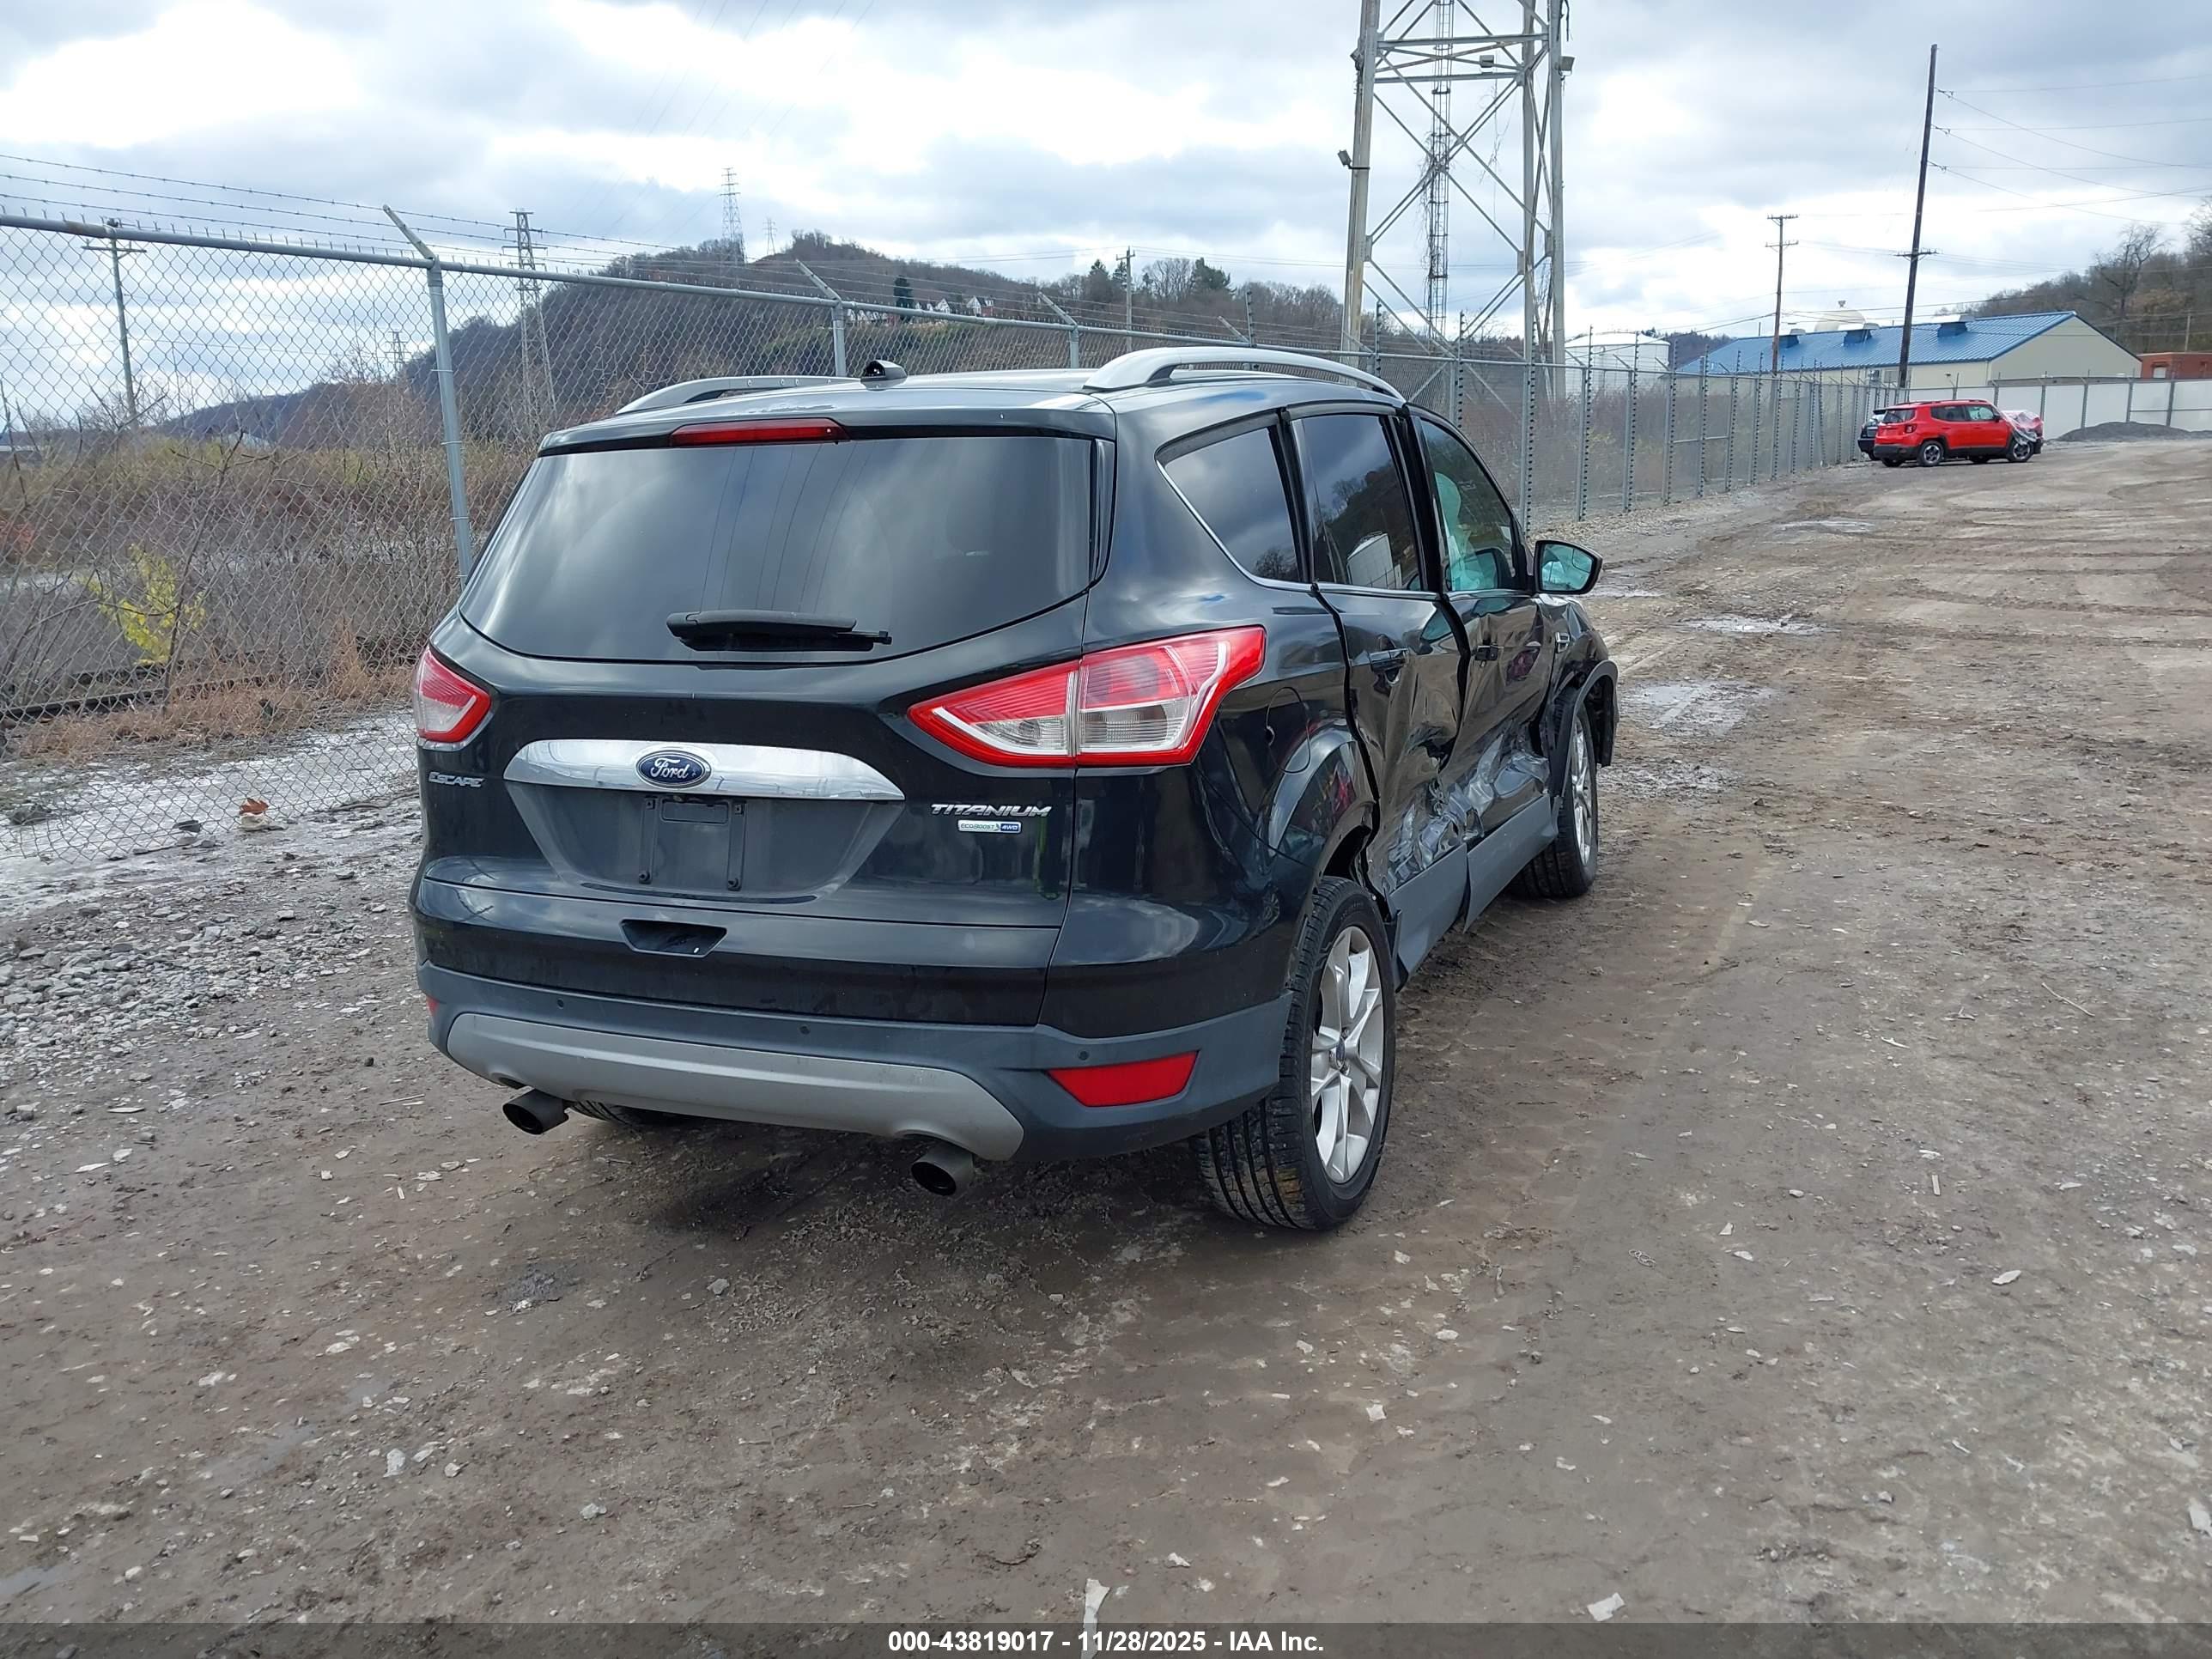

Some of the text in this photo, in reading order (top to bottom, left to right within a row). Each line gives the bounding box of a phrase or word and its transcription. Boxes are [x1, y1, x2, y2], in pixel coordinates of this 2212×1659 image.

[650, 757, 690, 779] Ford
[428, 771, 485, 787] ESCAPE
[931, 804, 1053, 817] TITANIUM
